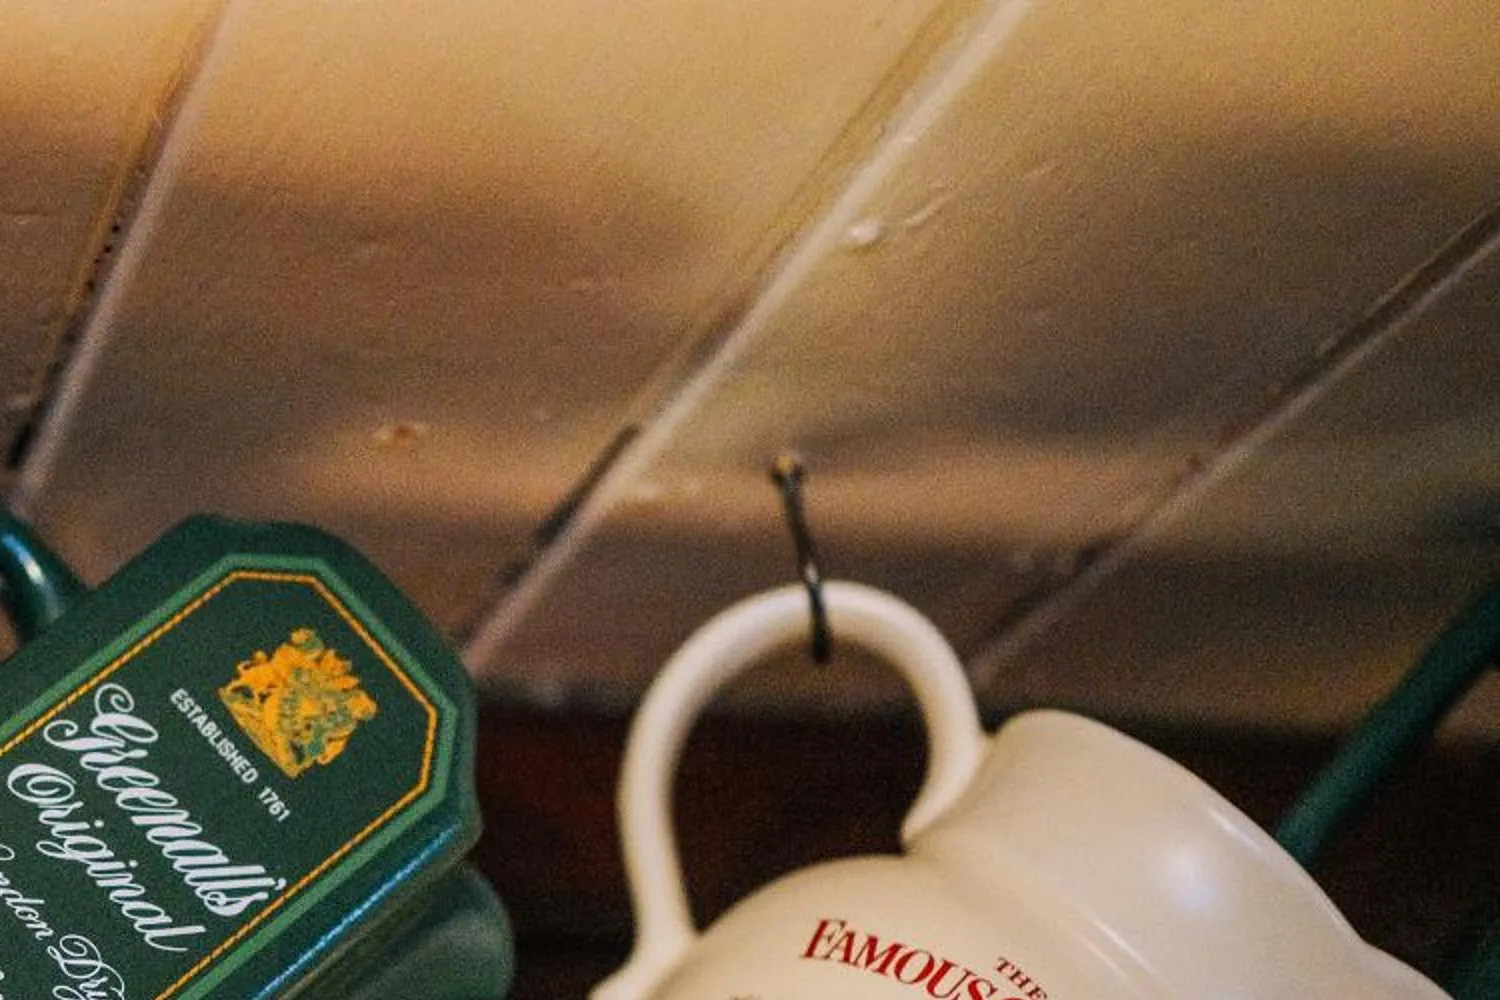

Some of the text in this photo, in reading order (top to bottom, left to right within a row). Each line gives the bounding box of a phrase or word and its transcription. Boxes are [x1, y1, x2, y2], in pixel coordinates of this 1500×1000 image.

[169, 687, 291, 823] ESTABLISHED 1761
[7, 763, 206, 952] Original
